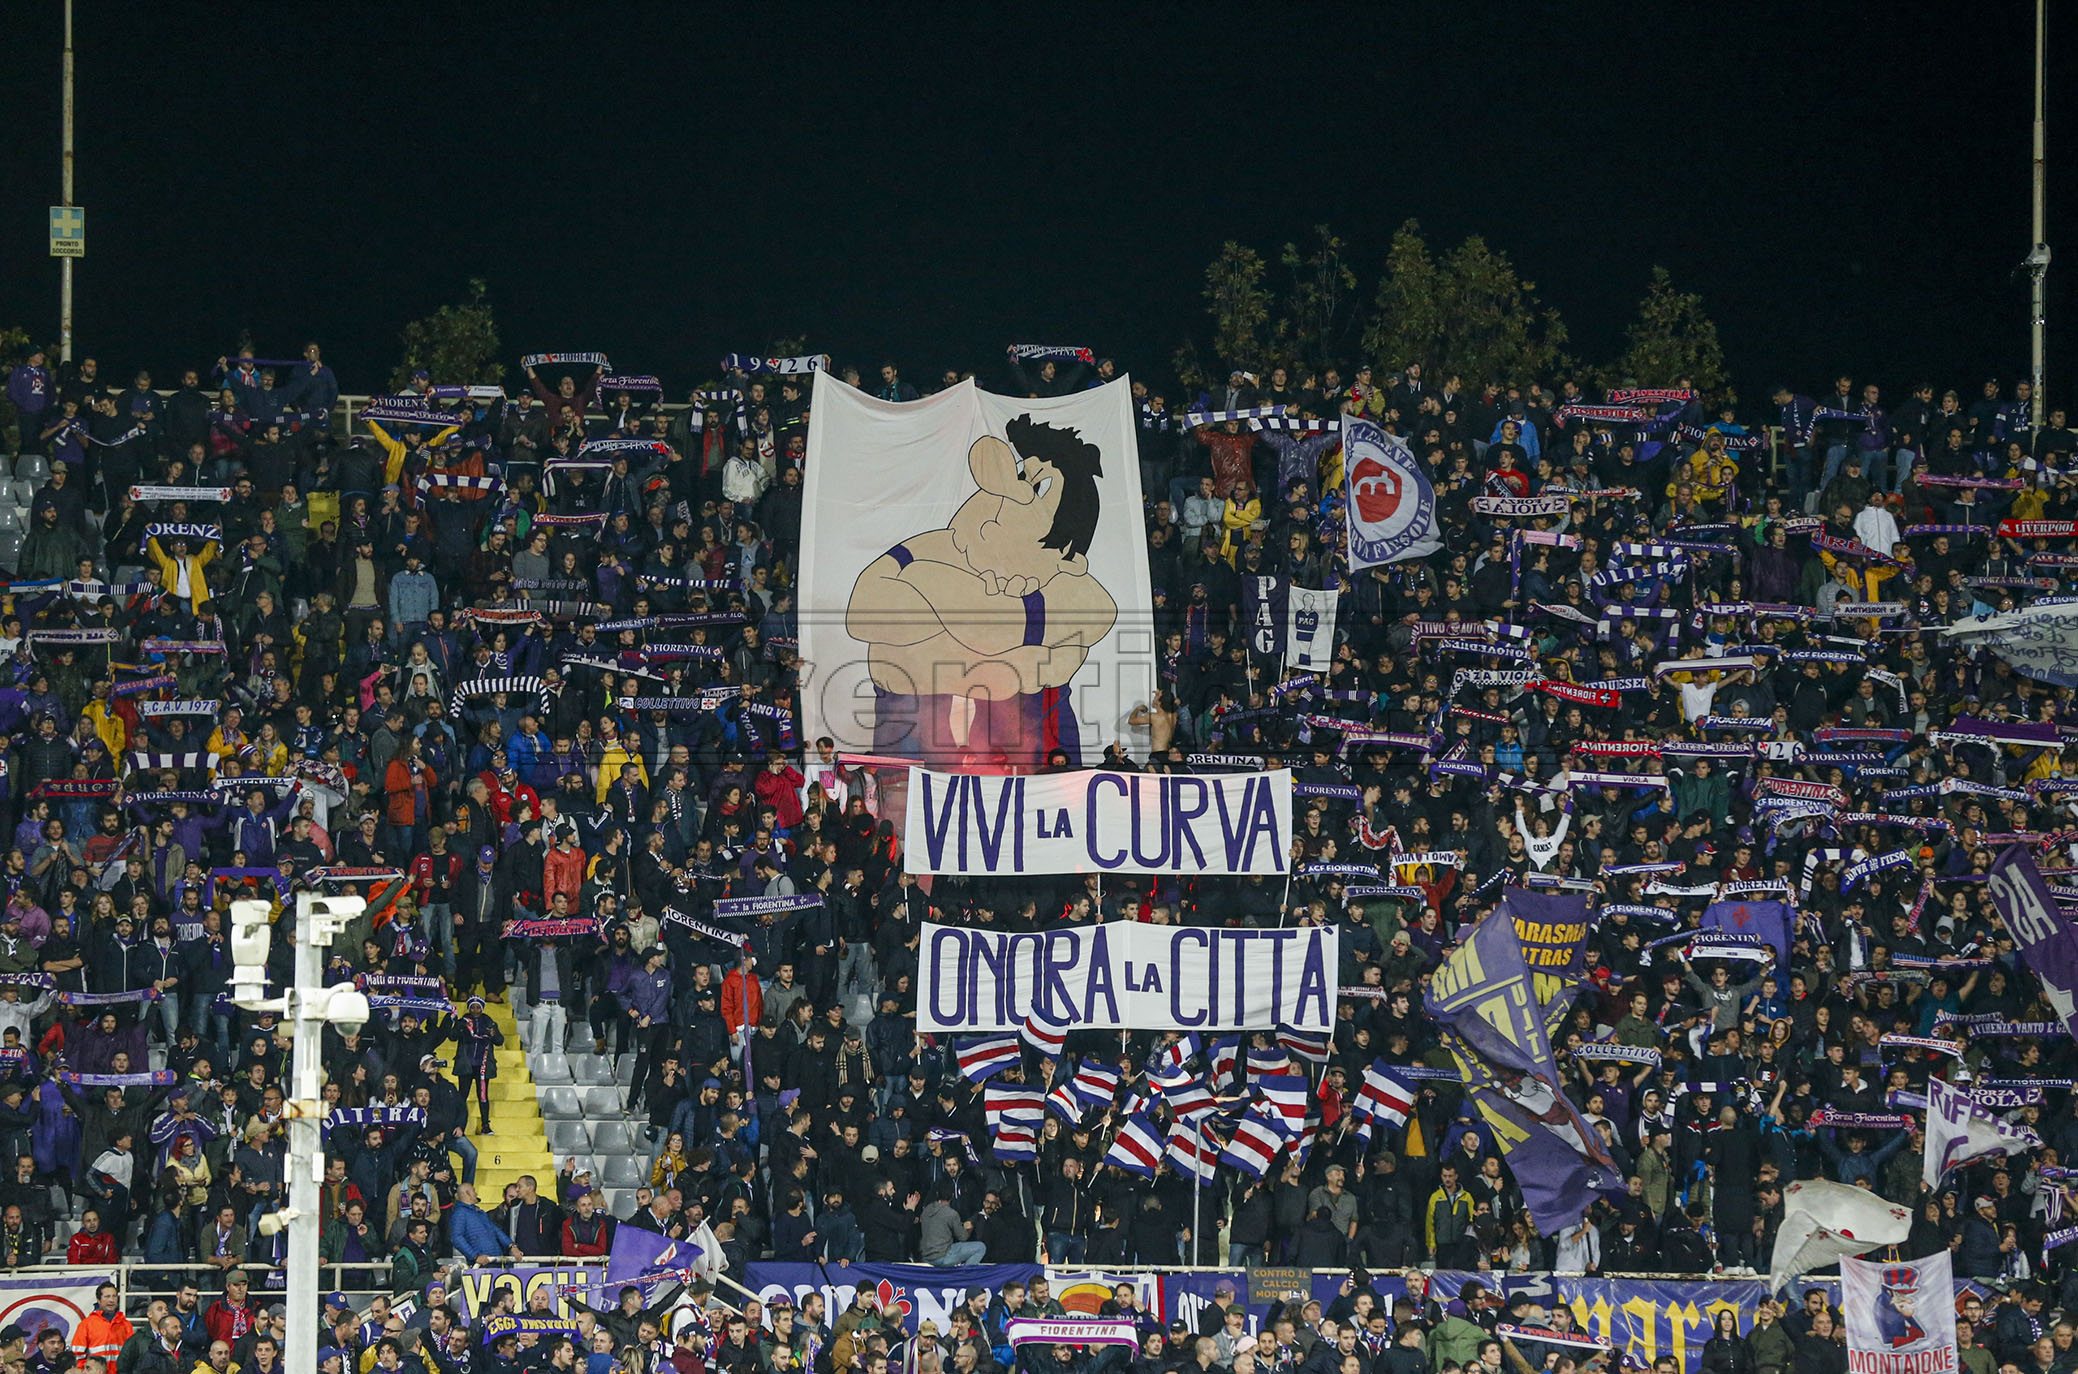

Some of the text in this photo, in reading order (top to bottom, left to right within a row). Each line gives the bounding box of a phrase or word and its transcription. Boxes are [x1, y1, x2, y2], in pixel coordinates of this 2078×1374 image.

[2015, 523, 2076, 533] LIVERPOOL
[653, 642, 712, 656] FIORENTINA
[635, 697, 701, 710] COLLETTIVO
[1809, 753, 1877, 762] FIORENTINA
[1438, 760, 1483, 775] FIORENTINA
[135, 789, 208, 801] FIORENTINA
[1304, 785, 1359, 798] FIORENTINA
[922, 773, 1286, 872] VIVI LA CURVA
[753, 899, 796, 911] FIORENTINA
[1512, 920, 1587, 945] ARASMA
[930, 926, 1120, 1026] ONORA
[1125, 961, 1163, 993] LA
[2016, 1022, 2044, 1034] VANTO
[1577, 1045, 1657, 1059] COLLETTIVO
[1825, 1111, 1901, 1123] Forza Fiorentina
[494, 1154, 502, 1166] 6
[1253, 1270, 1312, 1279] CONTRO IL
[1262, 1280, 1300, 1290] CALCIO
[1041, 1323, 1117, 1337] FIORENTINA
[1849, 1346, 1954, 1374] MONTAIONE
